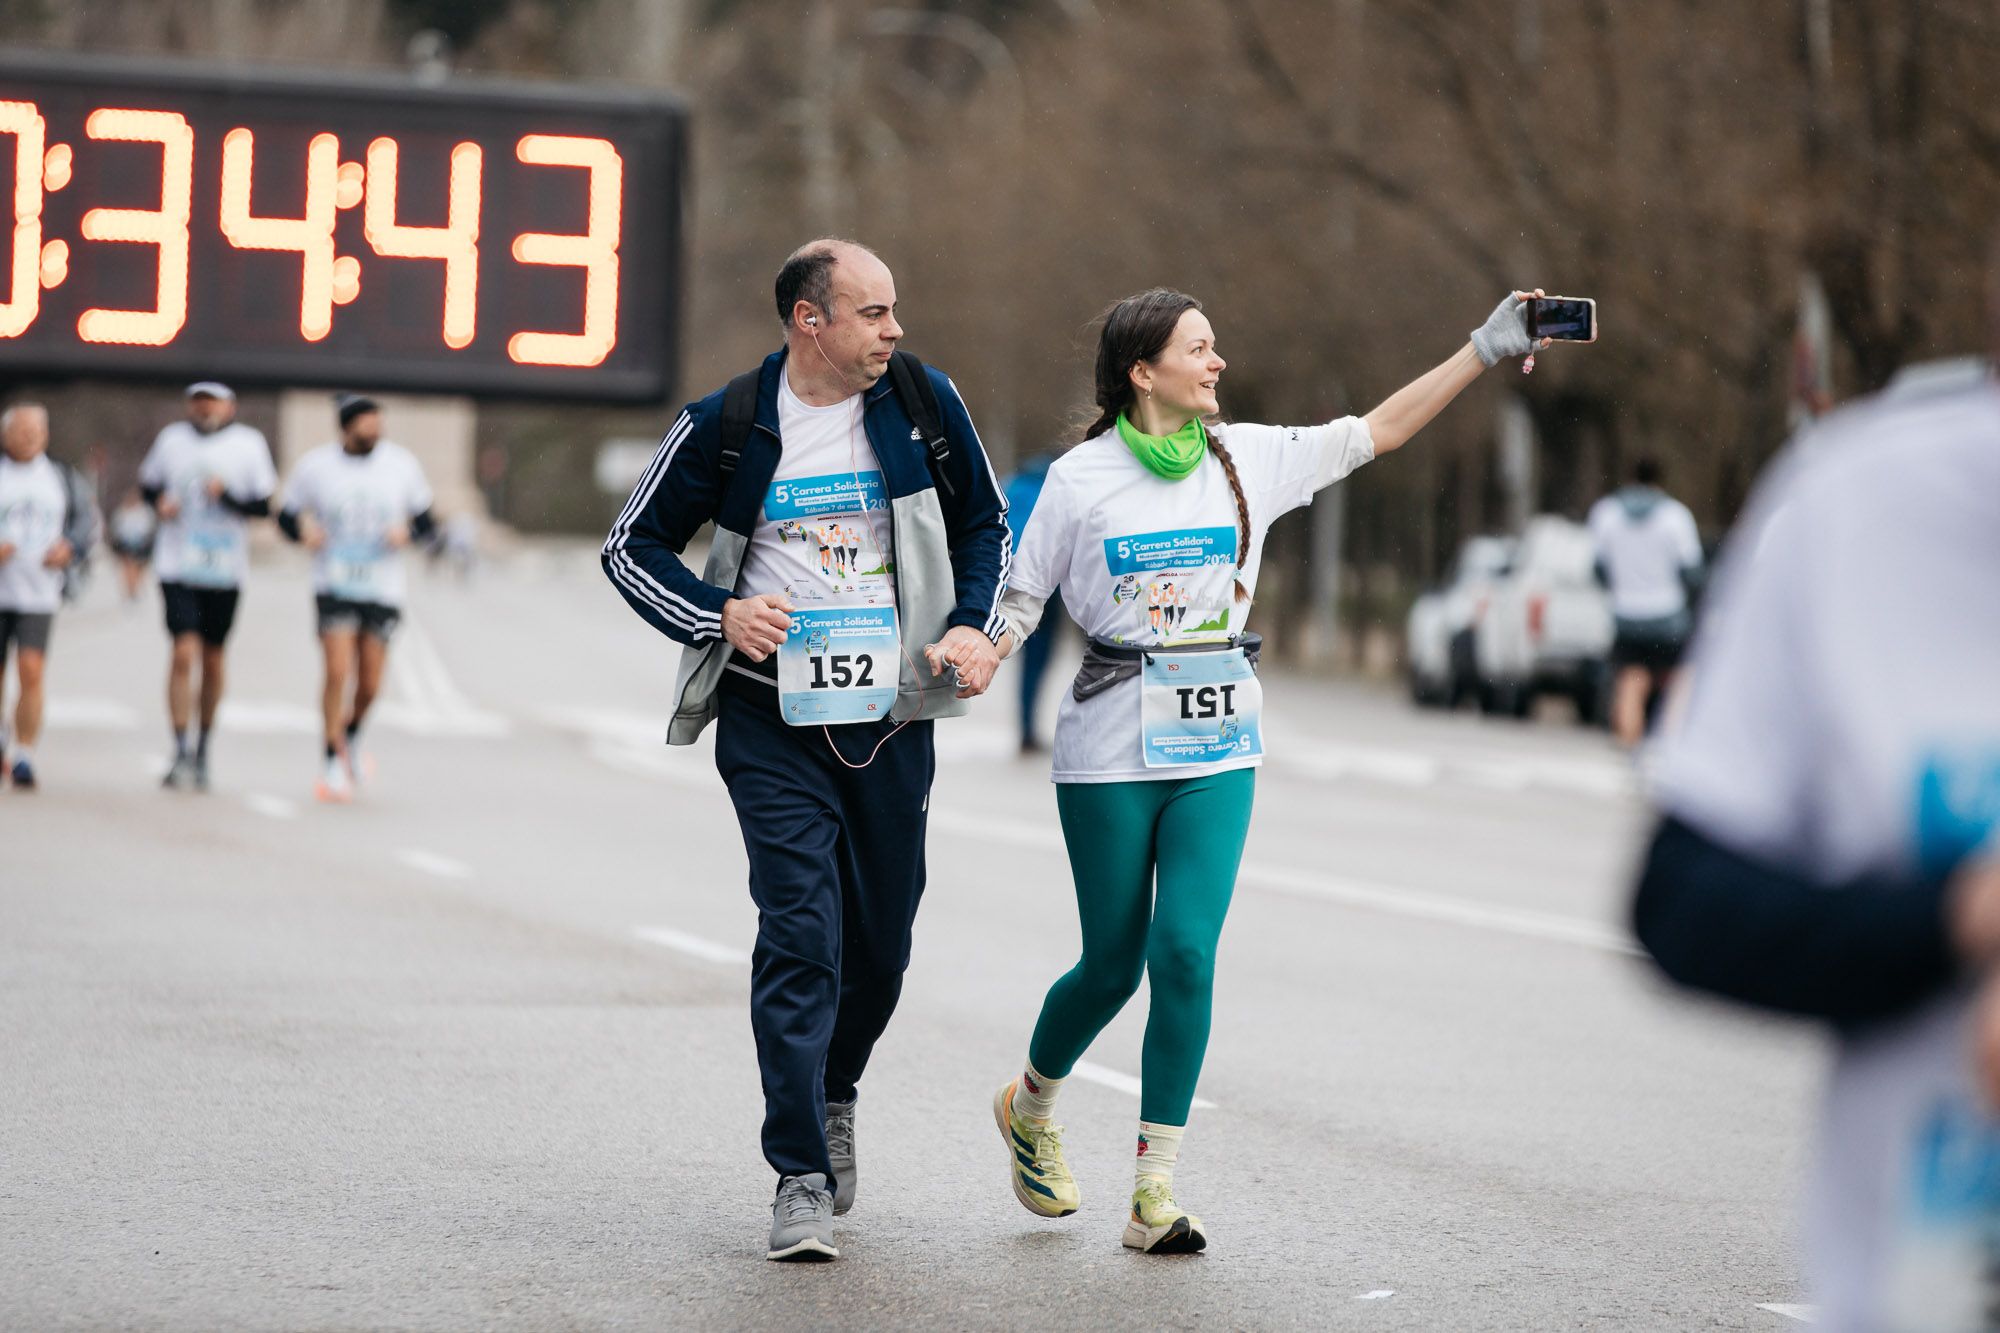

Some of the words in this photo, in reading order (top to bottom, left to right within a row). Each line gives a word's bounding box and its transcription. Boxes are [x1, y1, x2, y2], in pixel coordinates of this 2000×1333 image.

[791, 486, 832, 497] Carrera
[833, 479, 879, 491] Solidaria
[804, 505, 831, 514] Sábado
[1132, 541, 1172, 552] Carrera
[1173, 536, 1214, 547] Solidaria
[1144, 560, 1168, 569] Sábado
[1204, 553, 1231, 566] 2026
[803, 618, 841, 628] Carrera
[843, 616, 883, 626] Solidaria
[809, 653, 874, 689] 152
[1176, 684, 1236, 719] 151
[1164, 745, 1206, 755] Solidaria
[1207, 741, 1238, 752] Carrera
